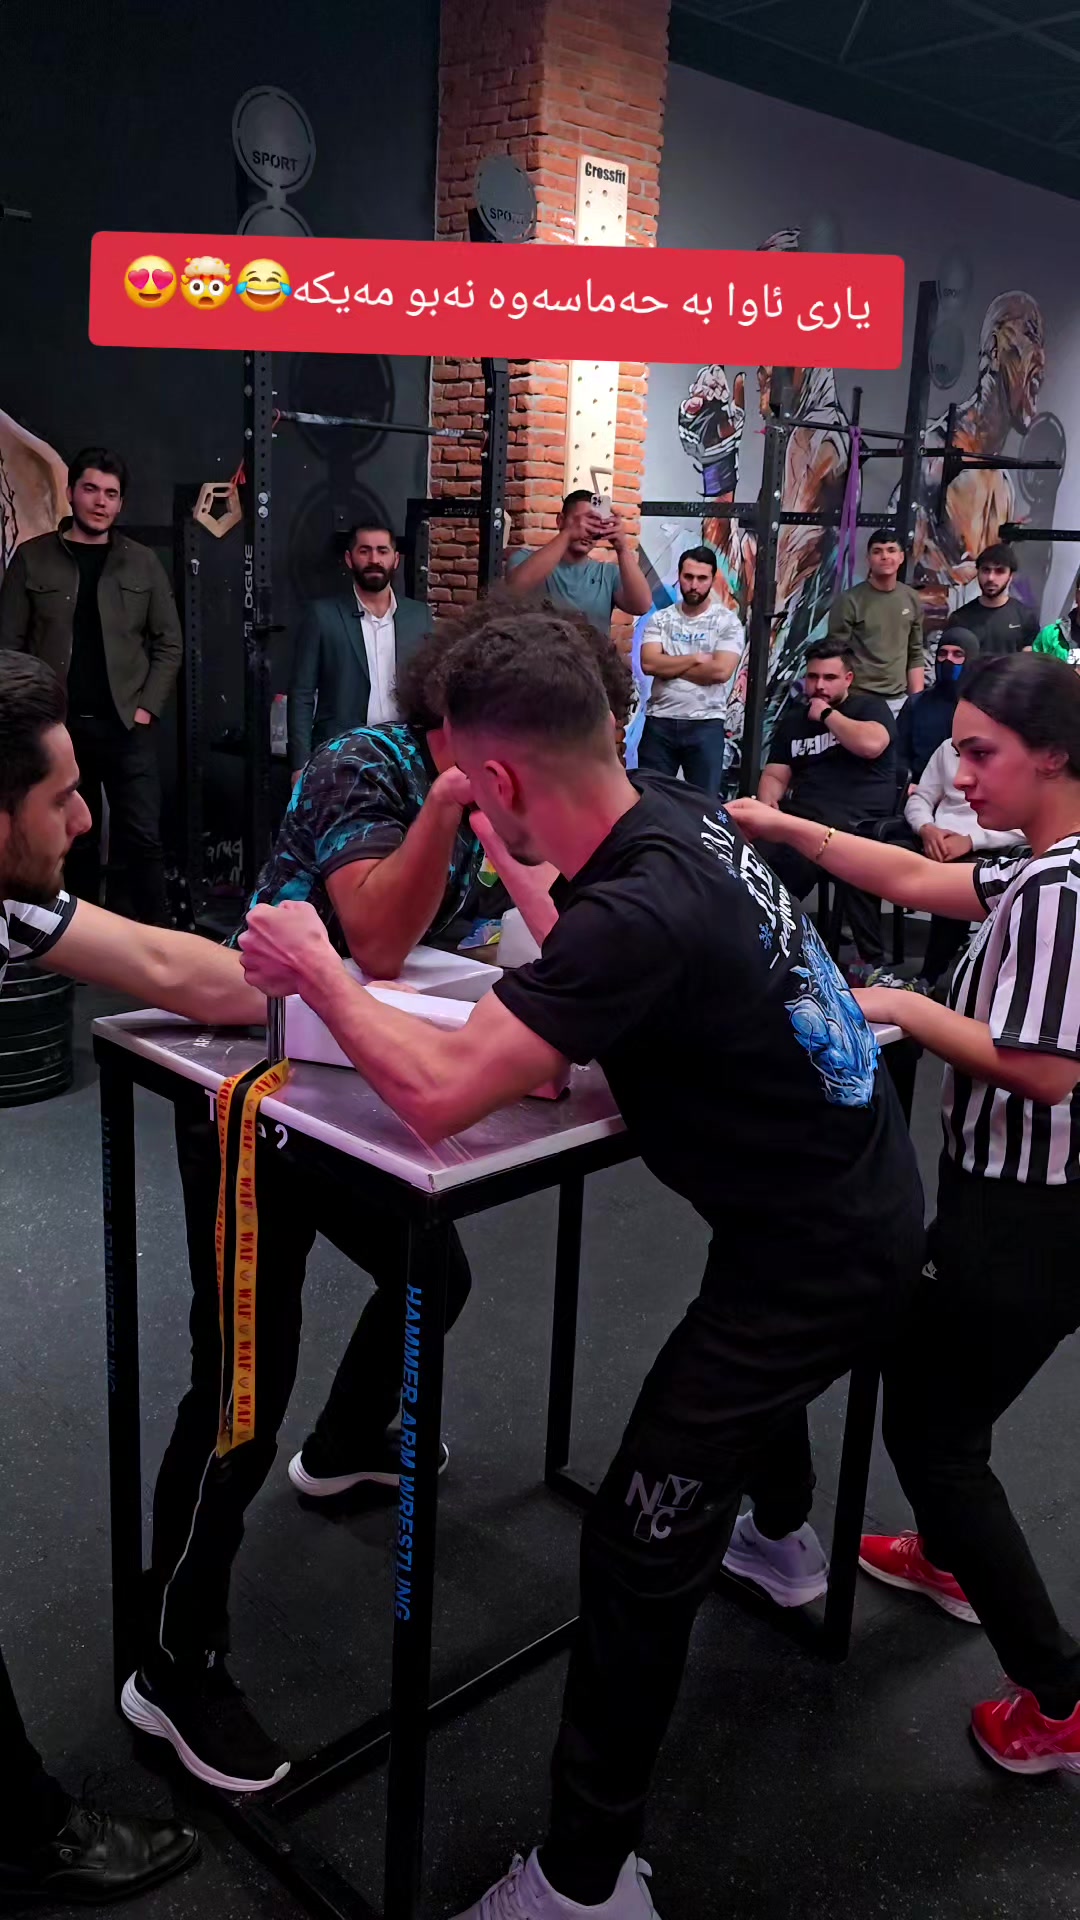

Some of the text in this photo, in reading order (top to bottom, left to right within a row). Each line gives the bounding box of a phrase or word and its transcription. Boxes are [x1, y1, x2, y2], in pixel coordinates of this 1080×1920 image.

[252, 150, 298, 172] SPORT
[585, 161, 626, 185] Crossfit
[244, 544, 254, 638] OGUE
[240, 1178, 253, 1208] WAF
[240, 1232, 254, 1264] WAF
[238, 1288, 252, 1320] WAF
[238, 1341, 252, 1372] WAF
[238, 1395, 251, 1427] WAF
[395, 1284, 422, 1621] HAMMER ARM WRESTLING
